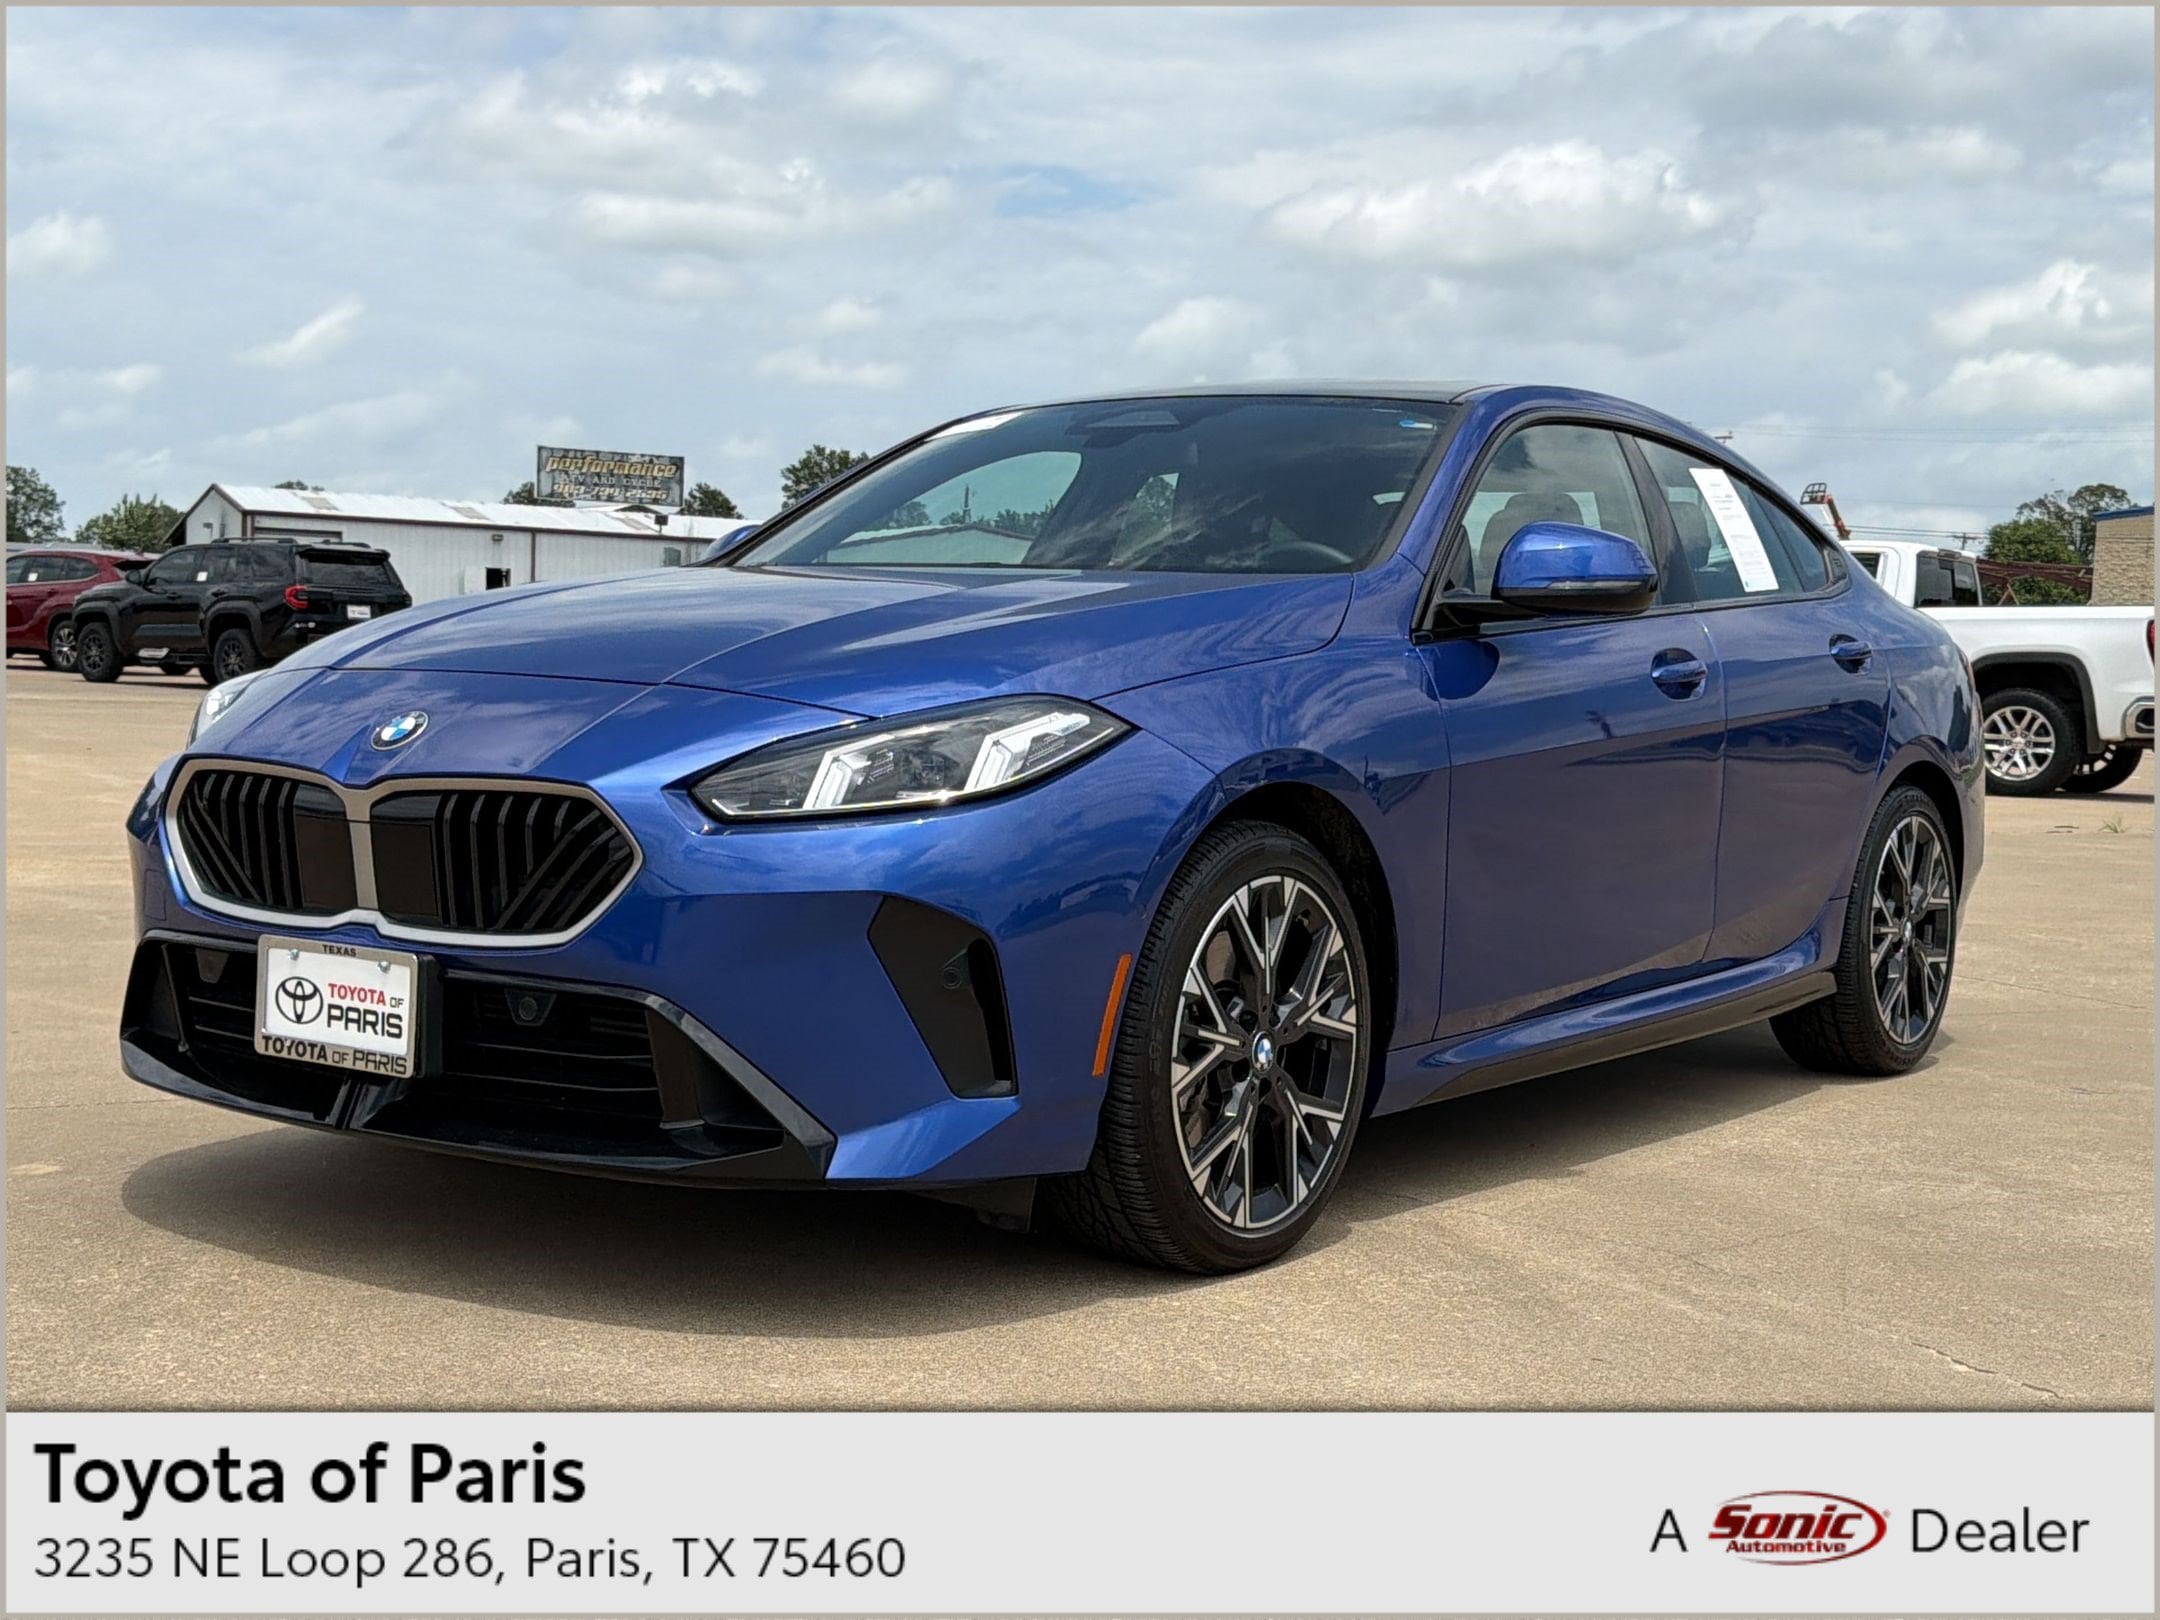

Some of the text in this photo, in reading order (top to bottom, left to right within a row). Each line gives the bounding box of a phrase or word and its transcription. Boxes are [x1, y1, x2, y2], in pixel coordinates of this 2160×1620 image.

[545, 456, 677, 478] performance
[322, 944, 357, 957] TEXAS
[328, 983, 404, 1008] TOYOTA OF
[327, 1003, 403, 1039] PARIS
[262, 1035, 407, 1075] TOYOTA OF PARIS
